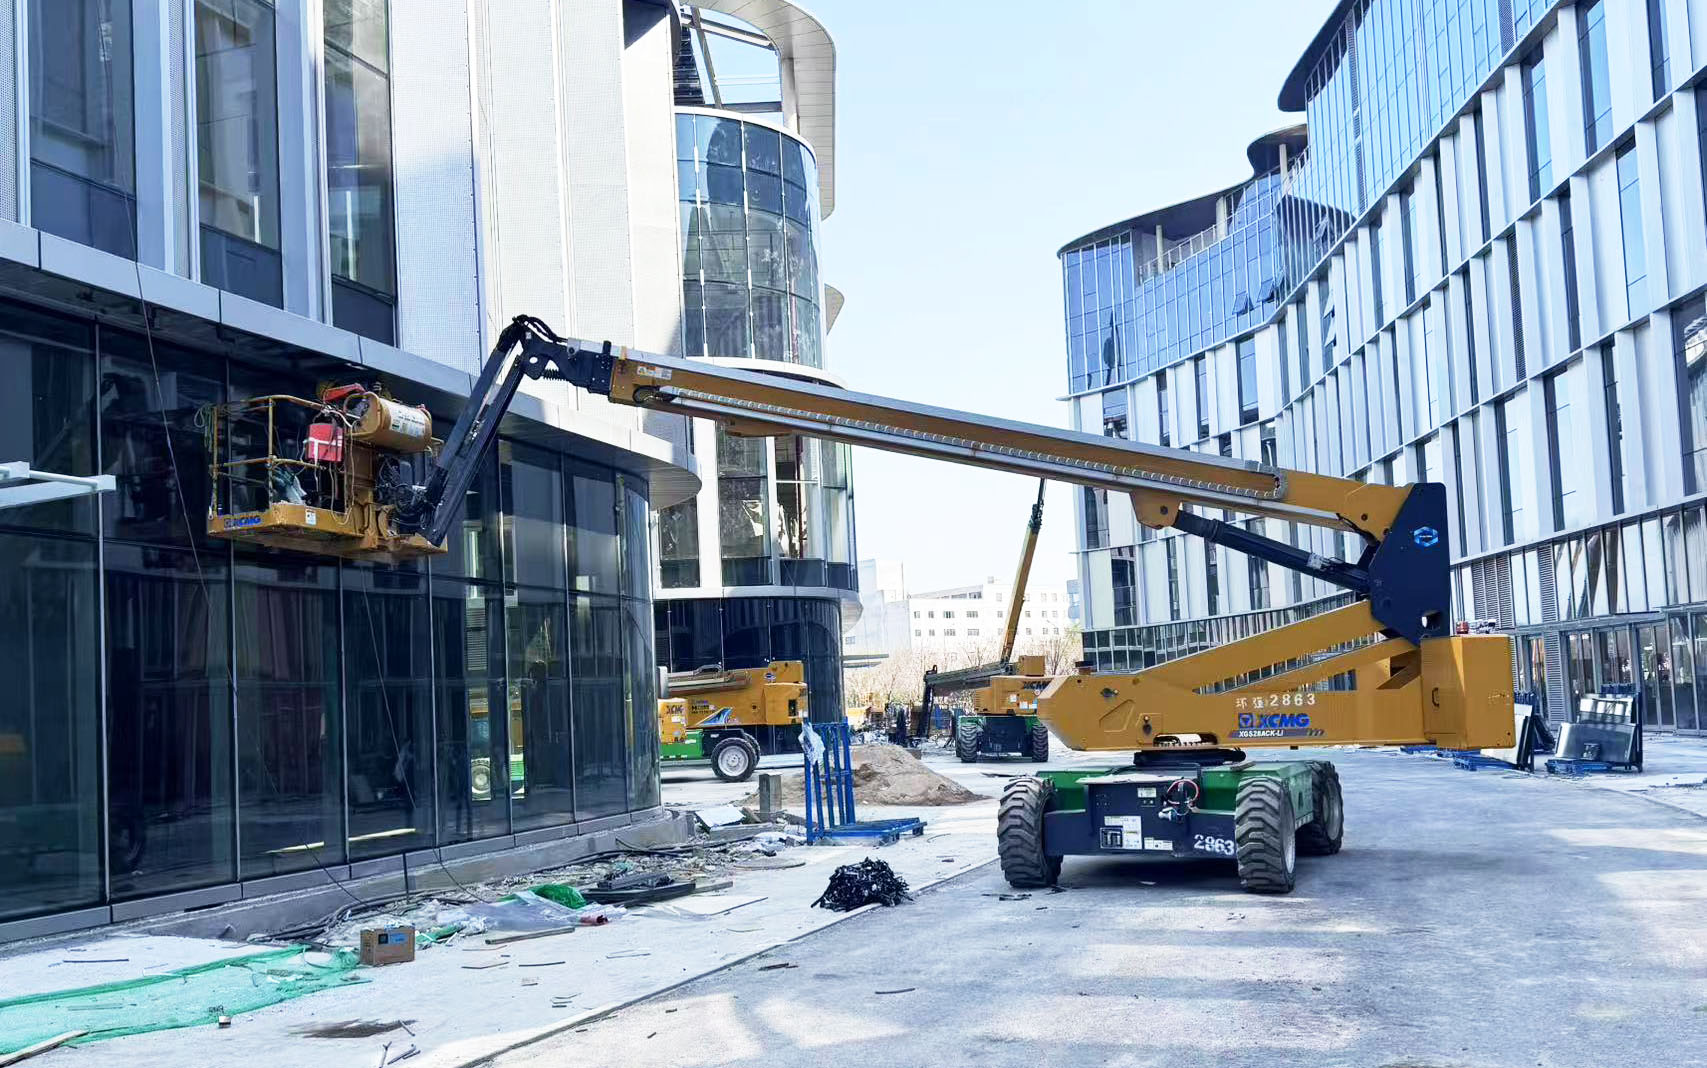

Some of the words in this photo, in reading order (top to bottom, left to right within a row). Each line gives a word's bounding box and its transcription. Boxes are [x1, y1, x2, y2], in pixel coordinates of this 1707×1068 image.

[1270, 693, 1315, 706] 2863
[1258, 713, 1310, 728] XCMG
[1193, 834, 1235, 856] 2863
